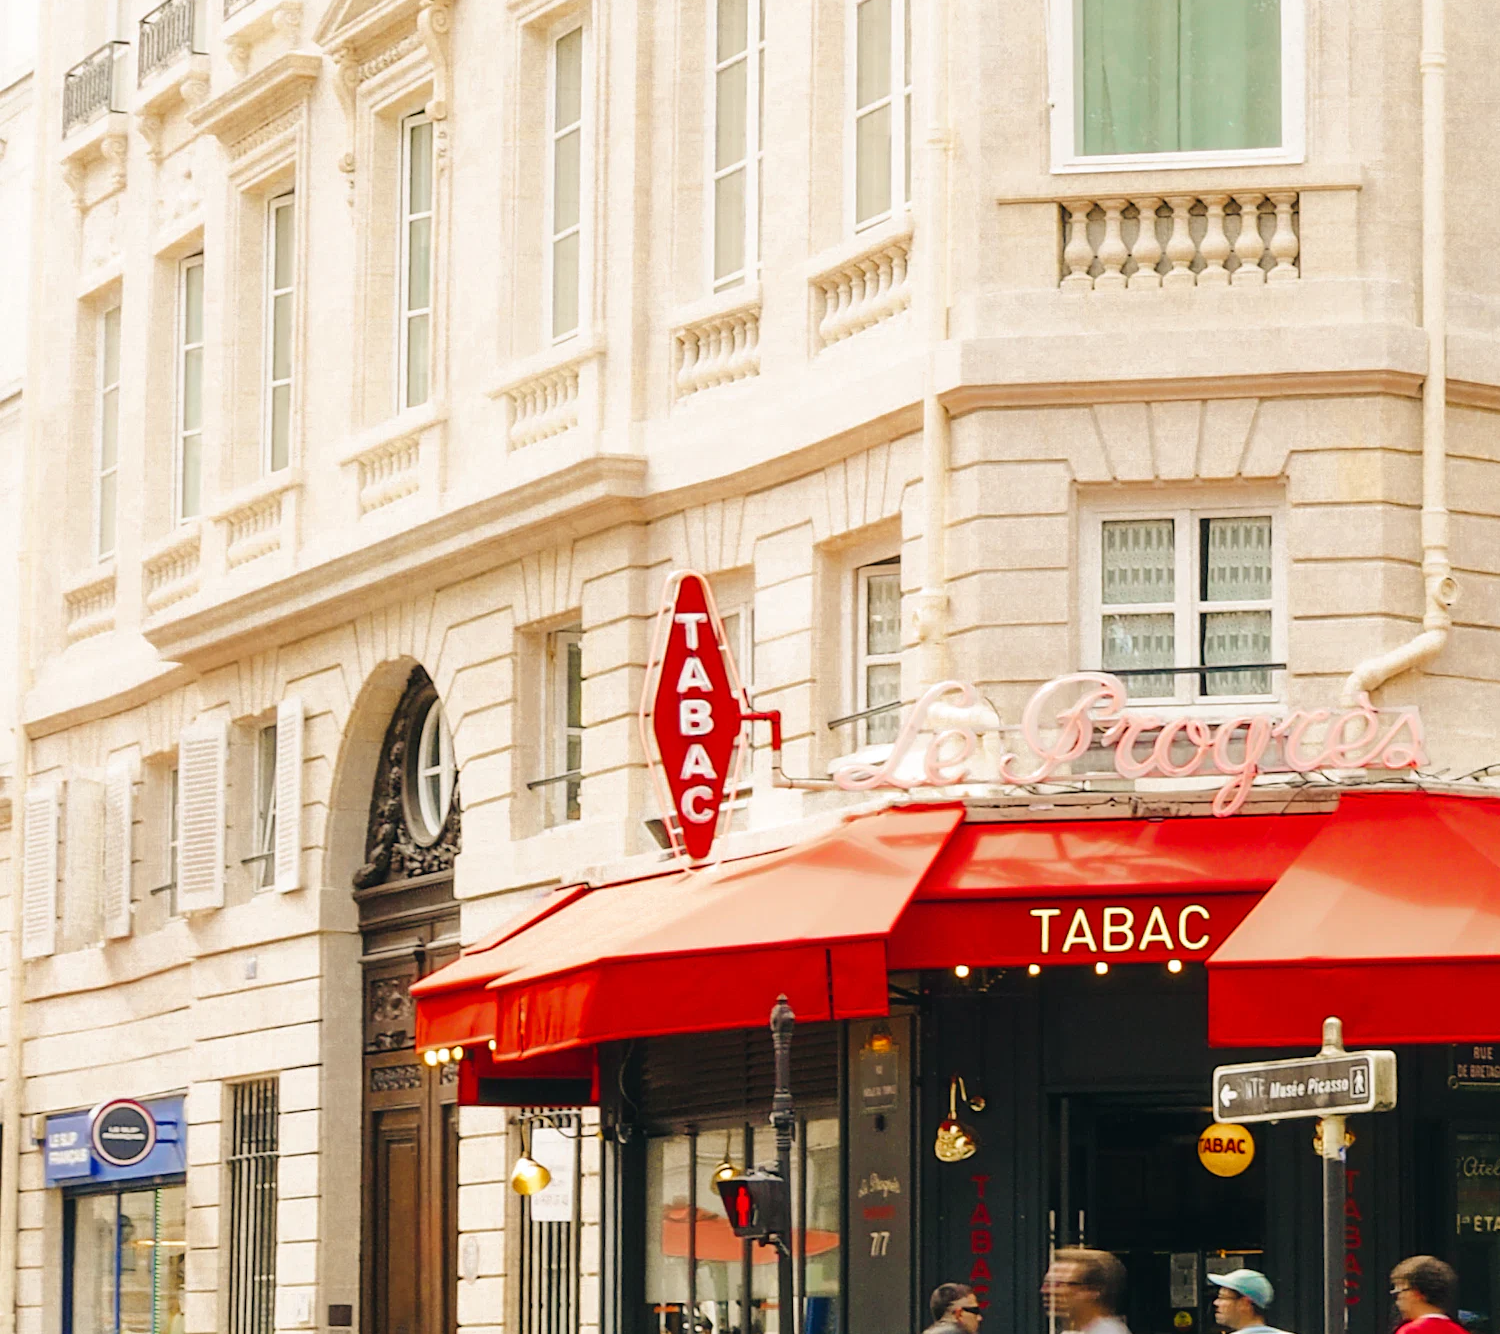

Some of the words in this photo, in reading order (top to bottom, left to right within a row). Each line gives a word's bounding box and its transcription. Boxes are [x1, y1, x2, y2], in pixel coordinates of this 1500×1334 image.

[674, 612, 718, 824] TABAC
[835, 679, 978, 791] Le
[1000, 671, 1424, 818] Progrès
[1029, 904, 1211, 954] TABAC
[1473, 1046, 1494, 1060] RUE
[1457, 1063, 1468, 1078] DE
[1269, 1080, 1306, 1099] Musée
[1307, 1077, 1349, 1095] Picasso
[870, 1231, 890, 1257] 77
